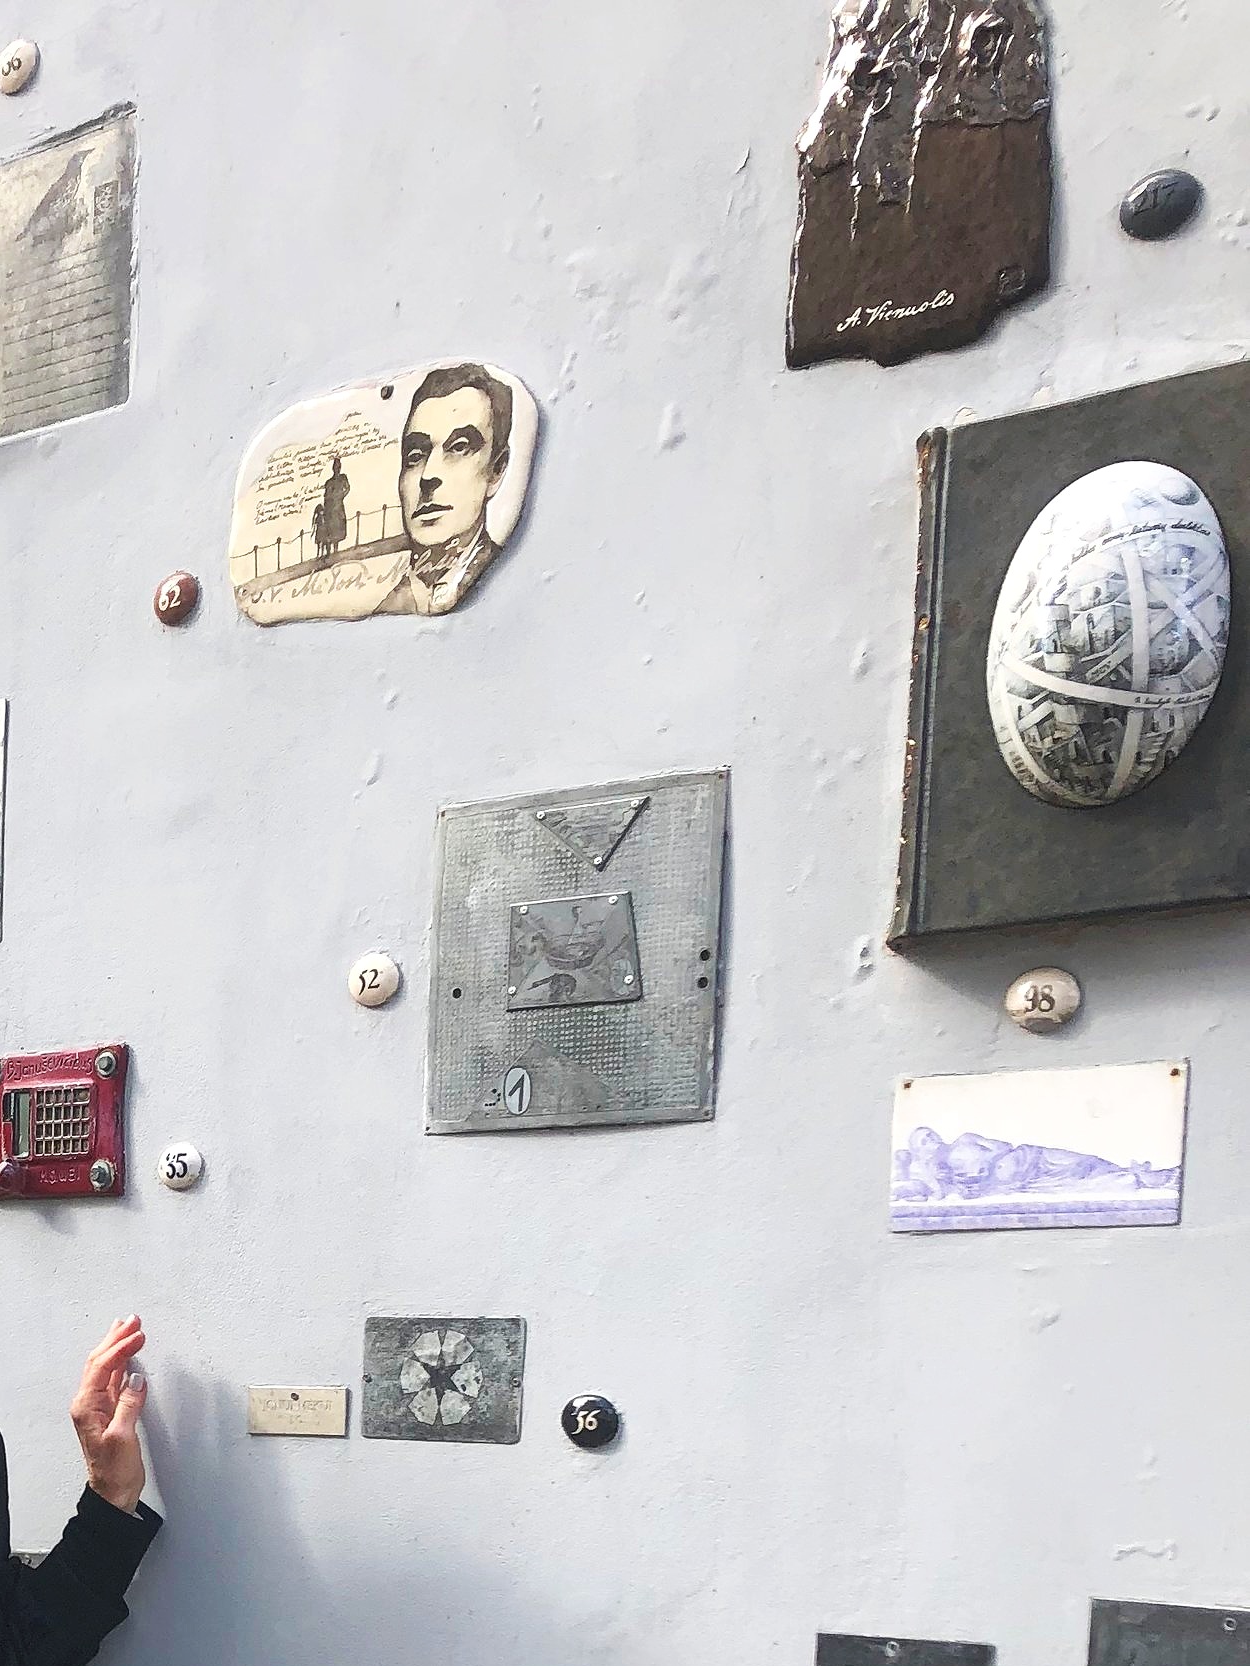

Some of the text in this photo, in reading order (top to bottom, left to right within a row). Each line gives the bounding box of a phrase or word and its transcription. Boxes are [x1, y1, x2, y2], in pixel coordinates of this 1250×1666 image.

[358, 968, 382, 996] 52
[1024, 984, 1056, 1013] 98
[508, 1073, 525, 1111] 1
[165, 1152, 189, 1179] 35
[571, 1409, 602, 1435] 56
